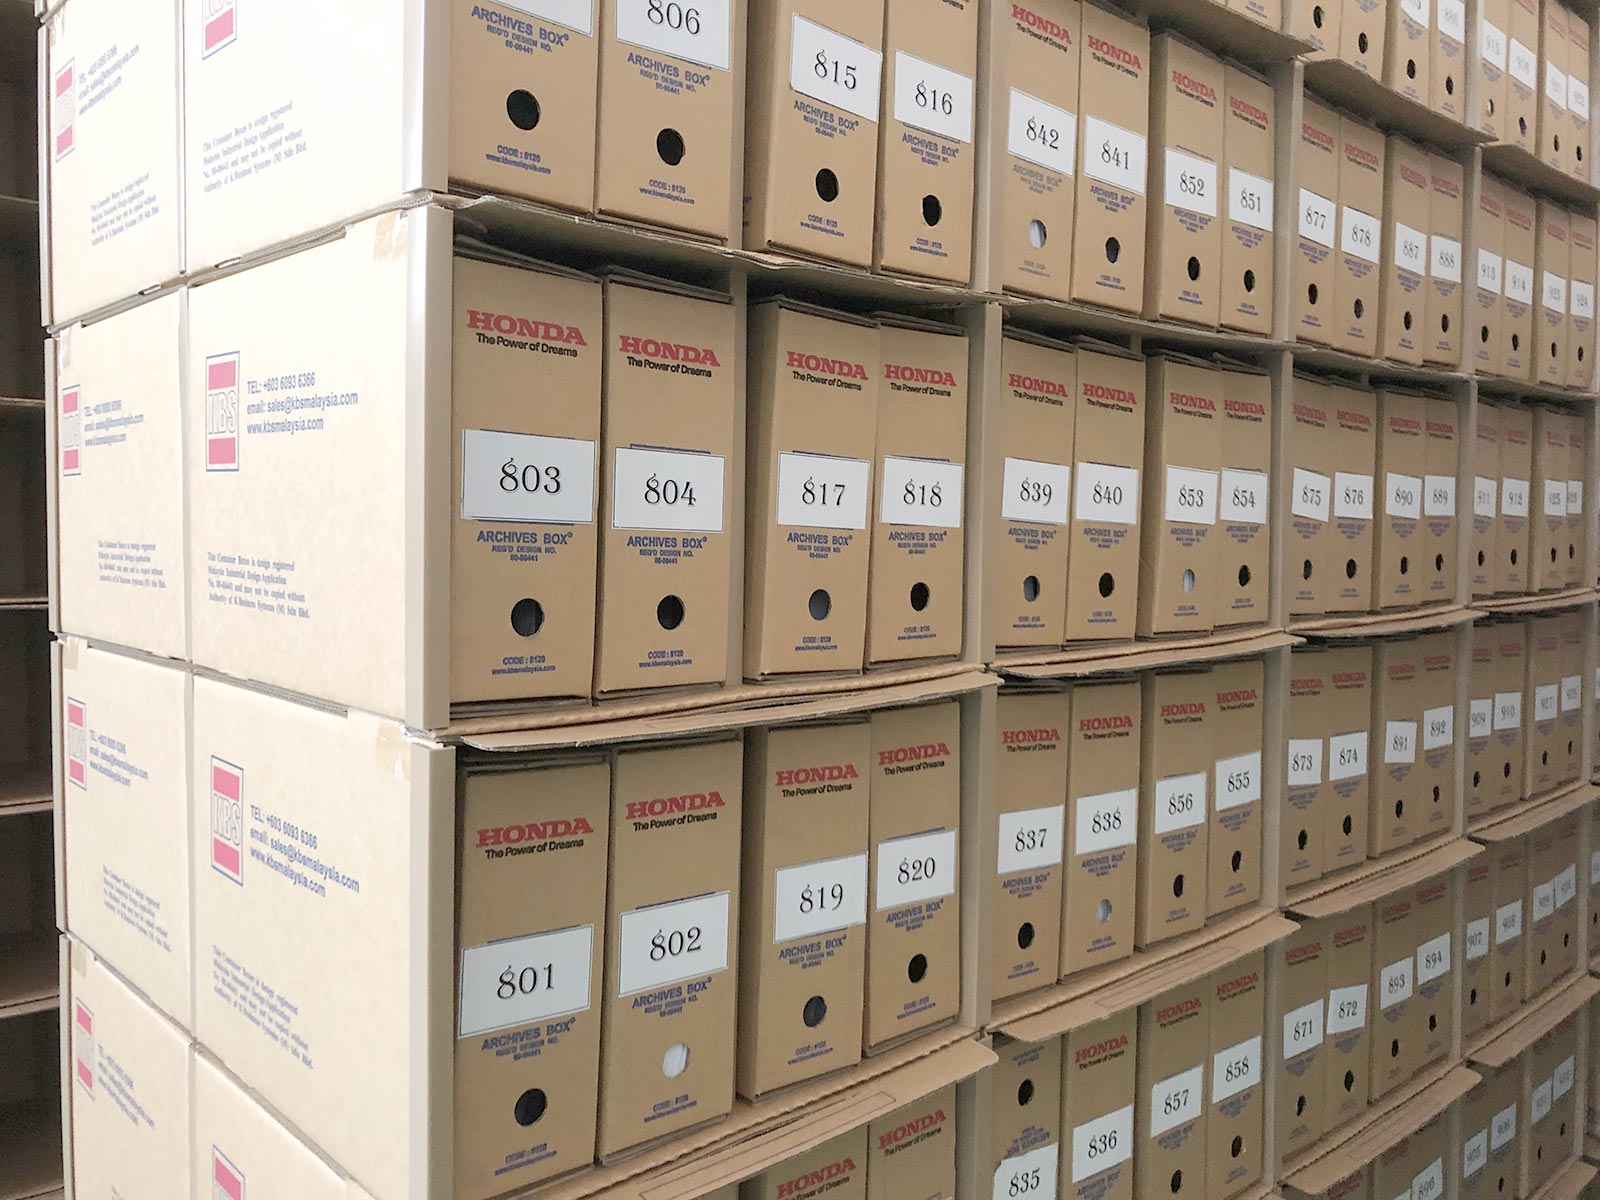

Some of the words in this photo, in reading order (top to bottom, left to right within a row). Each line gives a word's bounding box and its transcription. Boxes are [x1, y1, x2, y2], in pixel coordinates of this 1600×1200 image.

[472, 5, 533, 35] ARCHIVES
[648, 0, 700, 34] 806
[1012, 4, 1071, 44] HONDA
[1088, 34, 1142, 71] HONDA
[627, 53, 679, 77] ARCHIVES
[815, 50, 856, 89] 815
[915, 80, 952, 115] 816
[1172, 71, 1217, 100] HONDA
[794, 100, 834, 122] ARCHIVES
[1230, 96, 1269, 124] HONDA
[1027, 116, 1059, 149] 842
[1102, 140, 1128, 170] 841
[1180, 171, 1204, 197] 852
[1241, 188, 1260, 213] 851
[1306, 206, 1326, 229] 877
[1352, 224, 1371, 247] 878
[467, 309, 587, 346] HONDA
[476, 333, 495, 344] The
[497, 336, 530, 349] Power
[530, 342, 540, 351] of
[541, 343, 577, 357] Dreams
[619, 335, 720, 367] HONDA
[627, 356, 642, 367] The
[644, 359, 671, 371] Power
[671, 364, 680, 373] of
[681, 365, 712, 377] Dreams
[787, 352, 868, 381] HONDA
[885, 364, 957, 387] HONDA
[792, 371, 805, 381] The
[807, 374, 827, 384] Power
[827, 378, 836, 386] of
[836, 379, 862, 391] Dreams
[890, 382, 902, 391] The
[903, 384, 921, 393] Power
[929, 387, 951, 397] Dreams
[1009, 373, 1068, 397] HONDA
[1083, 384, 1136, 405] HONDA
[1168, 392, 1216, 411] HONDA
[1224, 400, 1265, 416] HONDA
[247, 417, 323, 435] www.kbsmalaysia.com
[500, 458, 560, 493] 803
[645, 473, 696, 505] 804
[802, 477, 845, 506] 817
[904, 479, 941, 507] 818
[1020, 478, 1051, 506] 839
[1093, 481, 1122, 505] 840
[1179, 484, 1203, 507] 853
[1233, 487, 1255, 507] 854
[1302, 485, 1321, 506] 875
[1345, 487, 1363, 505] 876
[1395, 486, 1413, 506] 890
[477, 530, 537, 543] ARCHIVES
[627, 536, 677, 547] ARCHIVES
[787, 532, 828, 544] ARCHIVES
[503, 657, 524, 665] CODE
[1216, 688, 1256, 704] HONDA
[1161, 703, 1206, 717] HONDA
[1080, 715, 1133, 732] HONDA
[1002, 728, 1059, 745] HONDA
[879, 742, 950, 766] HONDA
[1292, 752, 1313, 772] 873
[1339, 750, 1358, 766] 874
[775, 764, 858, 786] HONDA
[884, 767, 896, 775] The
[896, 765, 914, 774] Power
[915, 762, 922, 771] of
[923, 761, 945, 769] Dreams
[782, 789, 795, 797] The
[796, 787, 817, 796] Power
[817, 785, 826, 793] of
[827, 784, 852, 792] Dreams
[1228, 771, 1249, 792] 855
[626, 791, 725, 819] HONDA
[1169, 793, 1192, 815] 856
[214, 793, 240, 846] KBS
[250, 805, 264, 823] TEL:
[266, 814, 281, 832] +603
[633, 822, 649, 831] The
[650, 818, 675, 829] Power
[676, 815, 686, 825] of
[688, 812, 717, 823] Dreams
[1092, 808, 1122, 834] 838
[477, 817, 593, 848] HONDA
[1015, 828, 1047, 852] 837
[485, 849, 504, 859] The
[505, 846, 537, 856] Power
[537, 842, 548, 852] of
[549, 839, 584, 851] Dreams
[250, 847, 325, 897] www.kbsmalaysia.com
[271, 838, 359, 893] sales@kbsmalaysia.com
[898, 857, 935, 884] 820
[800, 884, 843, 913] 819
[650, 927, 701, 961] 802
[1425, 950, 1442, 969] 894
[497, 964, 553, 999] 801
[1216, 971, 1259, 998] HONDA
[632, 987, 682, 1008] ARCHIVES
[1339, 1000, 1357, 1019] 872
[1156, 997, 1201, 1023] HONDA
[482, 1028, 540, 1050] ARCHIVES
[1294, 1019, 1312, 1041] 871
[1075, 1035, 1128, 1063] HONDA
[1225, 1056, 1249, 1083] 858
[1164, 1089, 1189, 1115] 857
[879, 1106, 947, 1149] HONDA
[1088, 1130, 1117, 1158] 836
[778, 1157, 856, 1200] HONDA
[1009, 1168, 1040, 1197] 835
